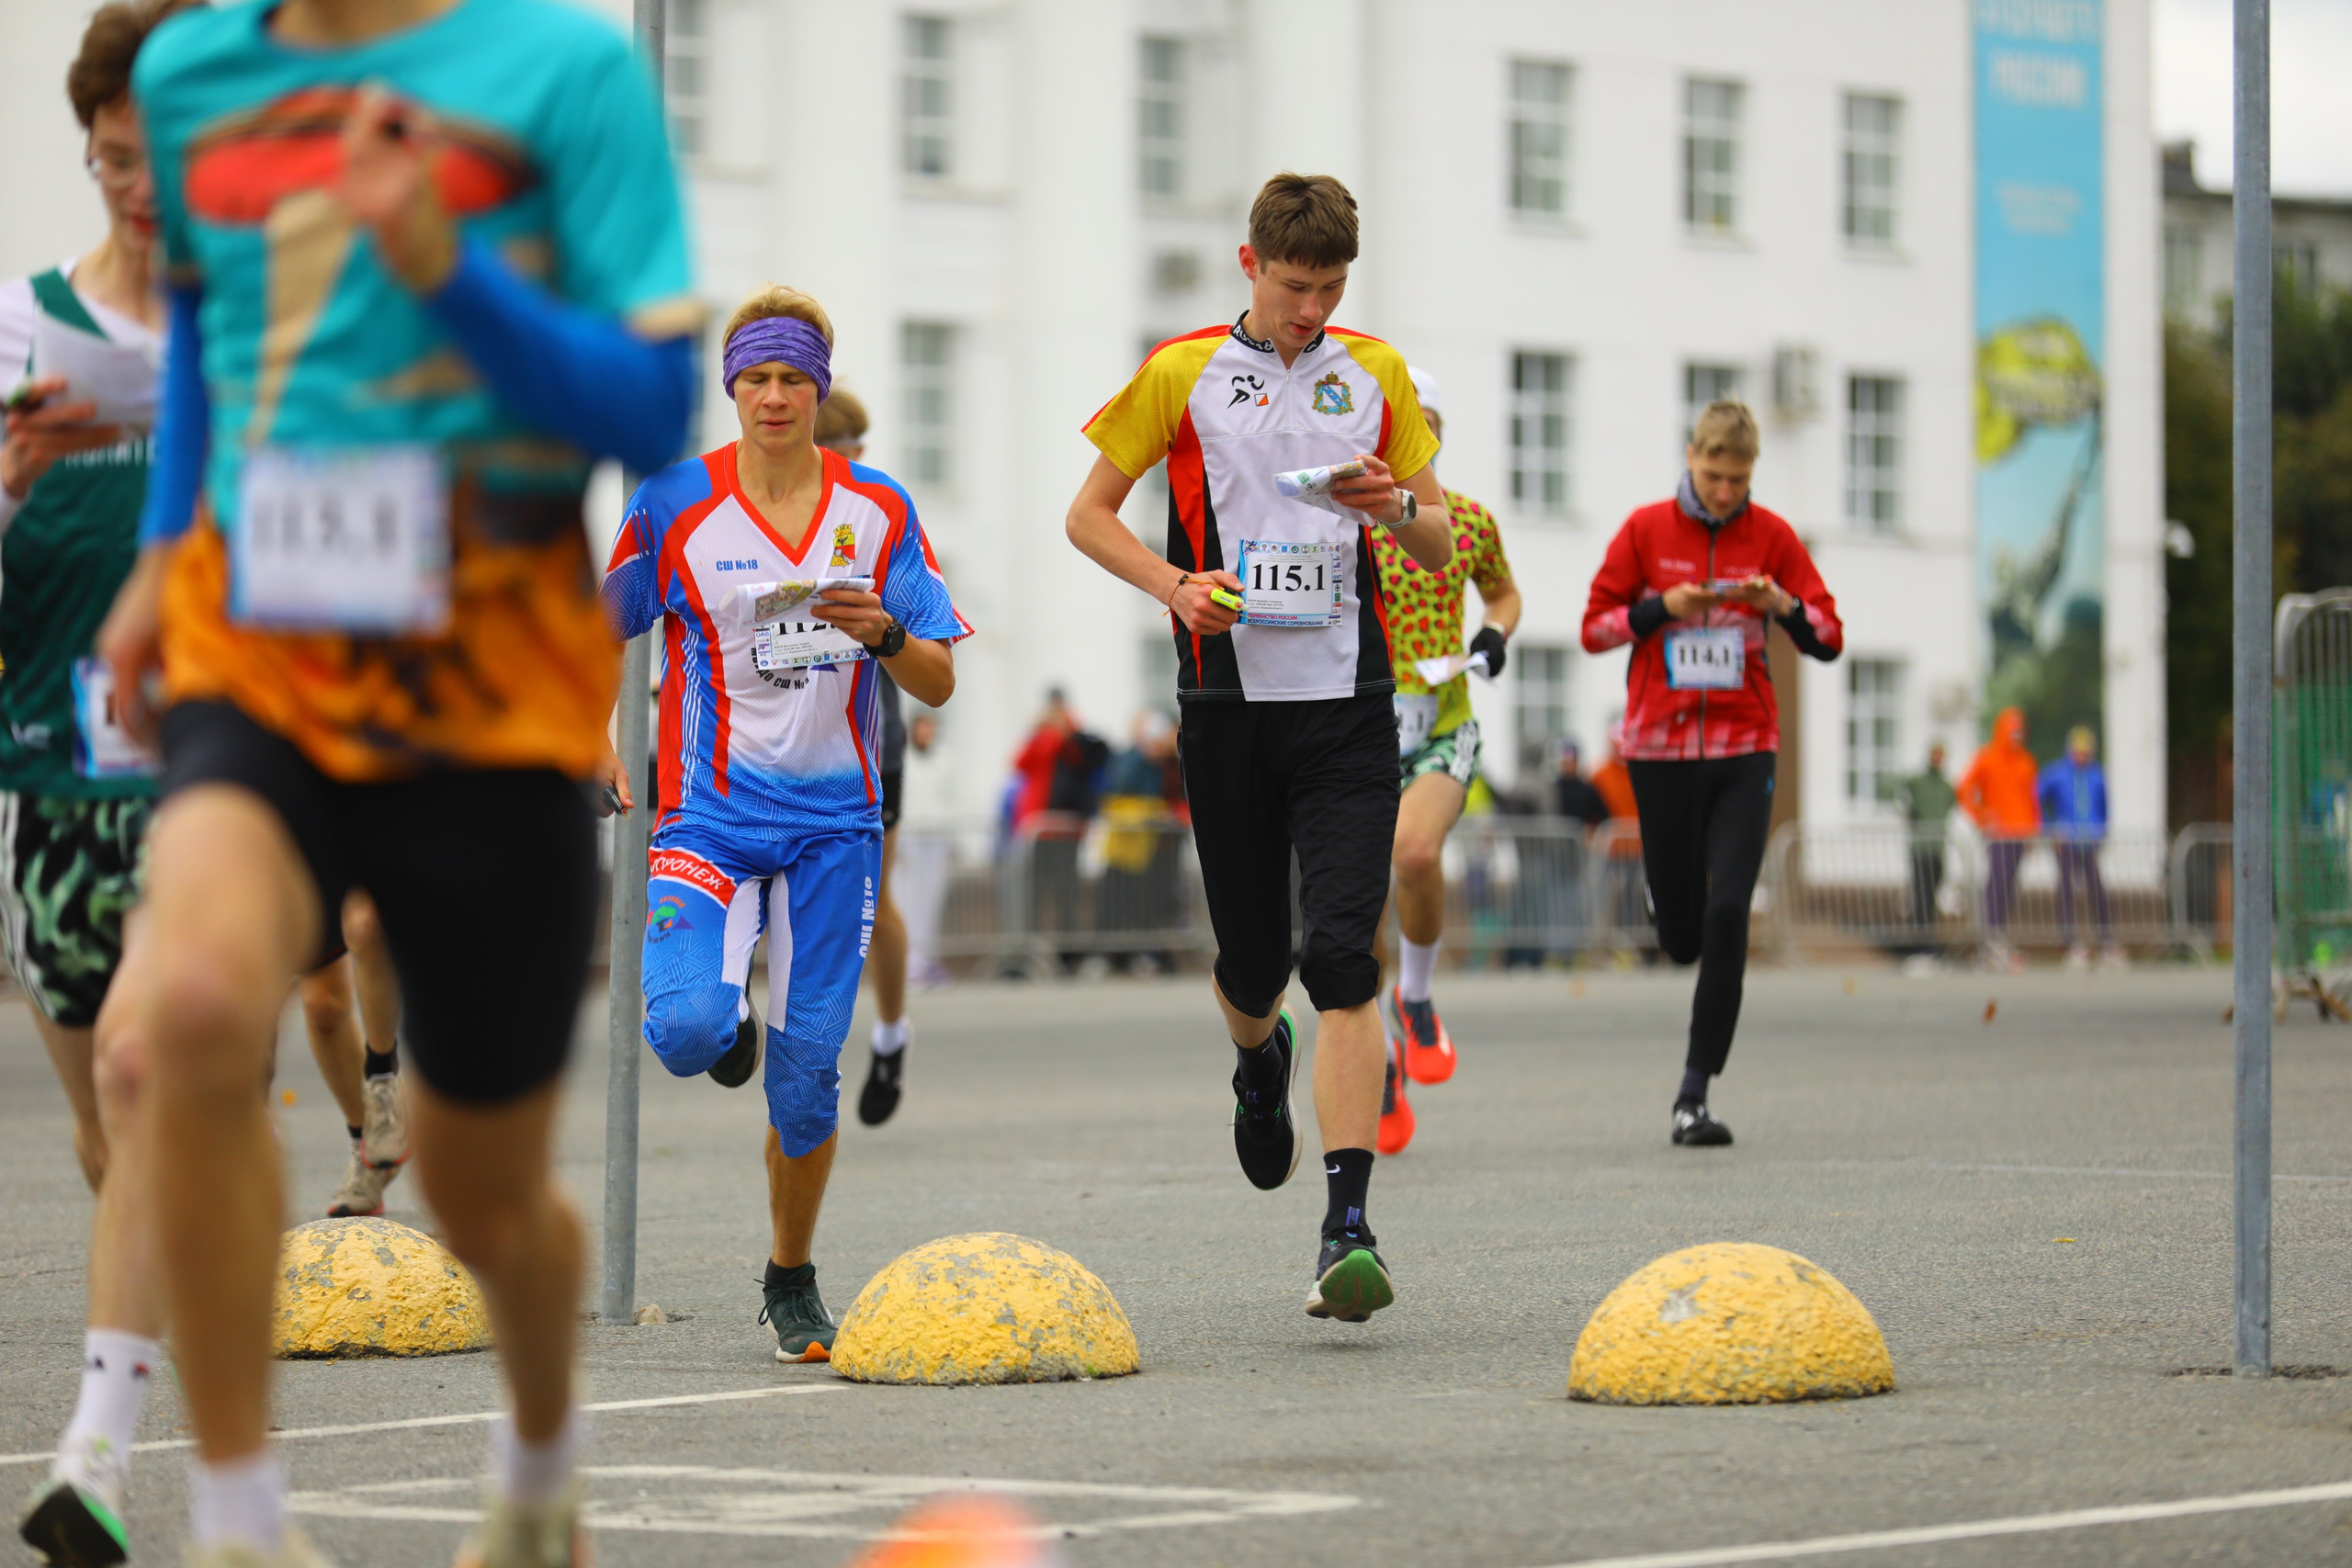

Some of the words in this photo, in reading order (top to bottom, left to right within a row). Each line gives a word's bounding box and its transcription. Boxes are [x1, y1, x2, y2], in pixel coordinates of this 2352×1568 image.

[717, 560, 733, 571] СШ
[735, 559, 758, 570] №18
[1251, 563, 1326, 592] 115.1
[773, 677, 791, 689] СШ
